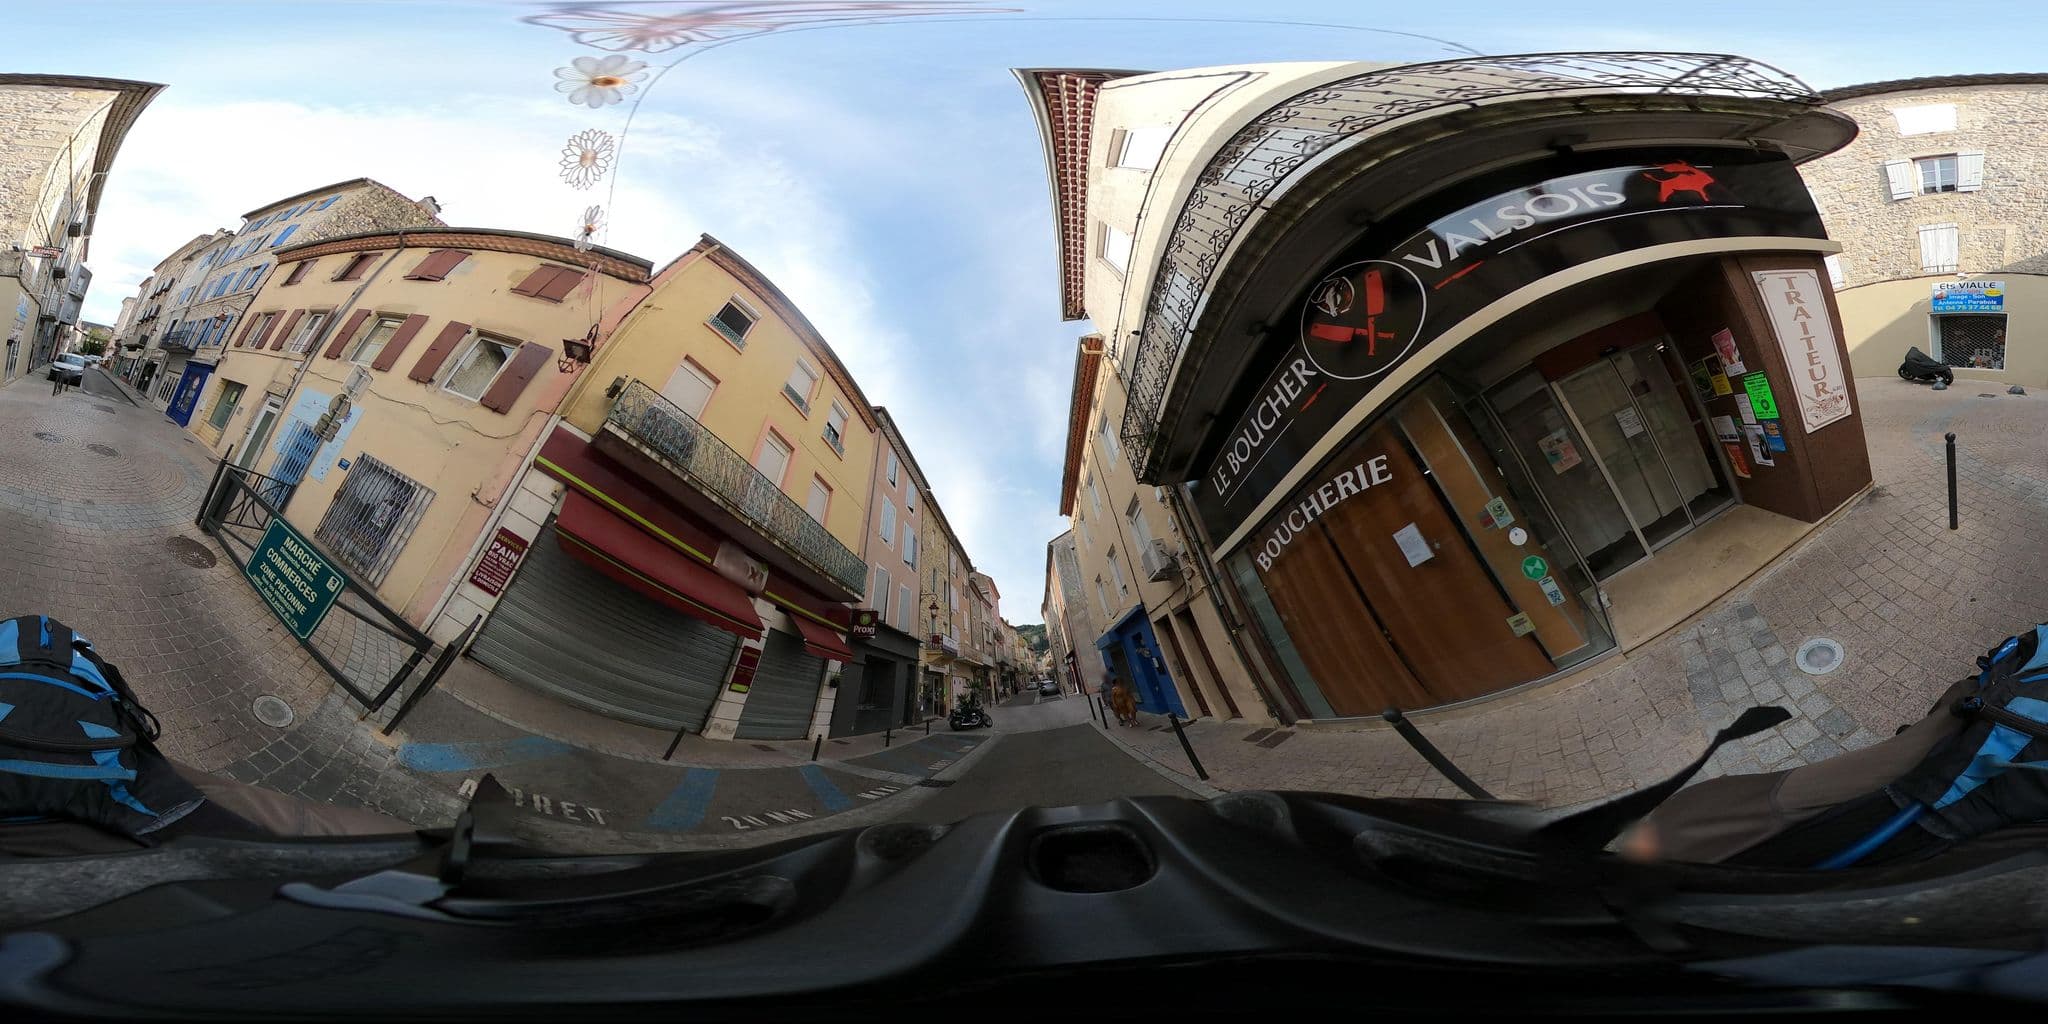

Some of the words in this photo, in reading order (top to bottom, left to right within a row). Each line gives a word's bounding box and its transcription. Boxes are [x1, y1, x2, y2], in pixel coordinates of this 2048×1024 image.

[1212, 465, 1231, 497] LE
[1226, 358, 1317, 475] BOUCHER
[1402, 183, 1627, 269] VALSOIS
[1778, 276, 1833, 398] TRAITEUR
[1256, 454, 1393, 572] BOUCHERIE
[266, 547, 318, 603] COMMERCES
[283, 536, 322, 576] MARCHÉ
[491, 541, 519, 563] PAIN
[260, 561, 277, 582] ZONE
[274, 578, 307, 615] PIÉTONNE
